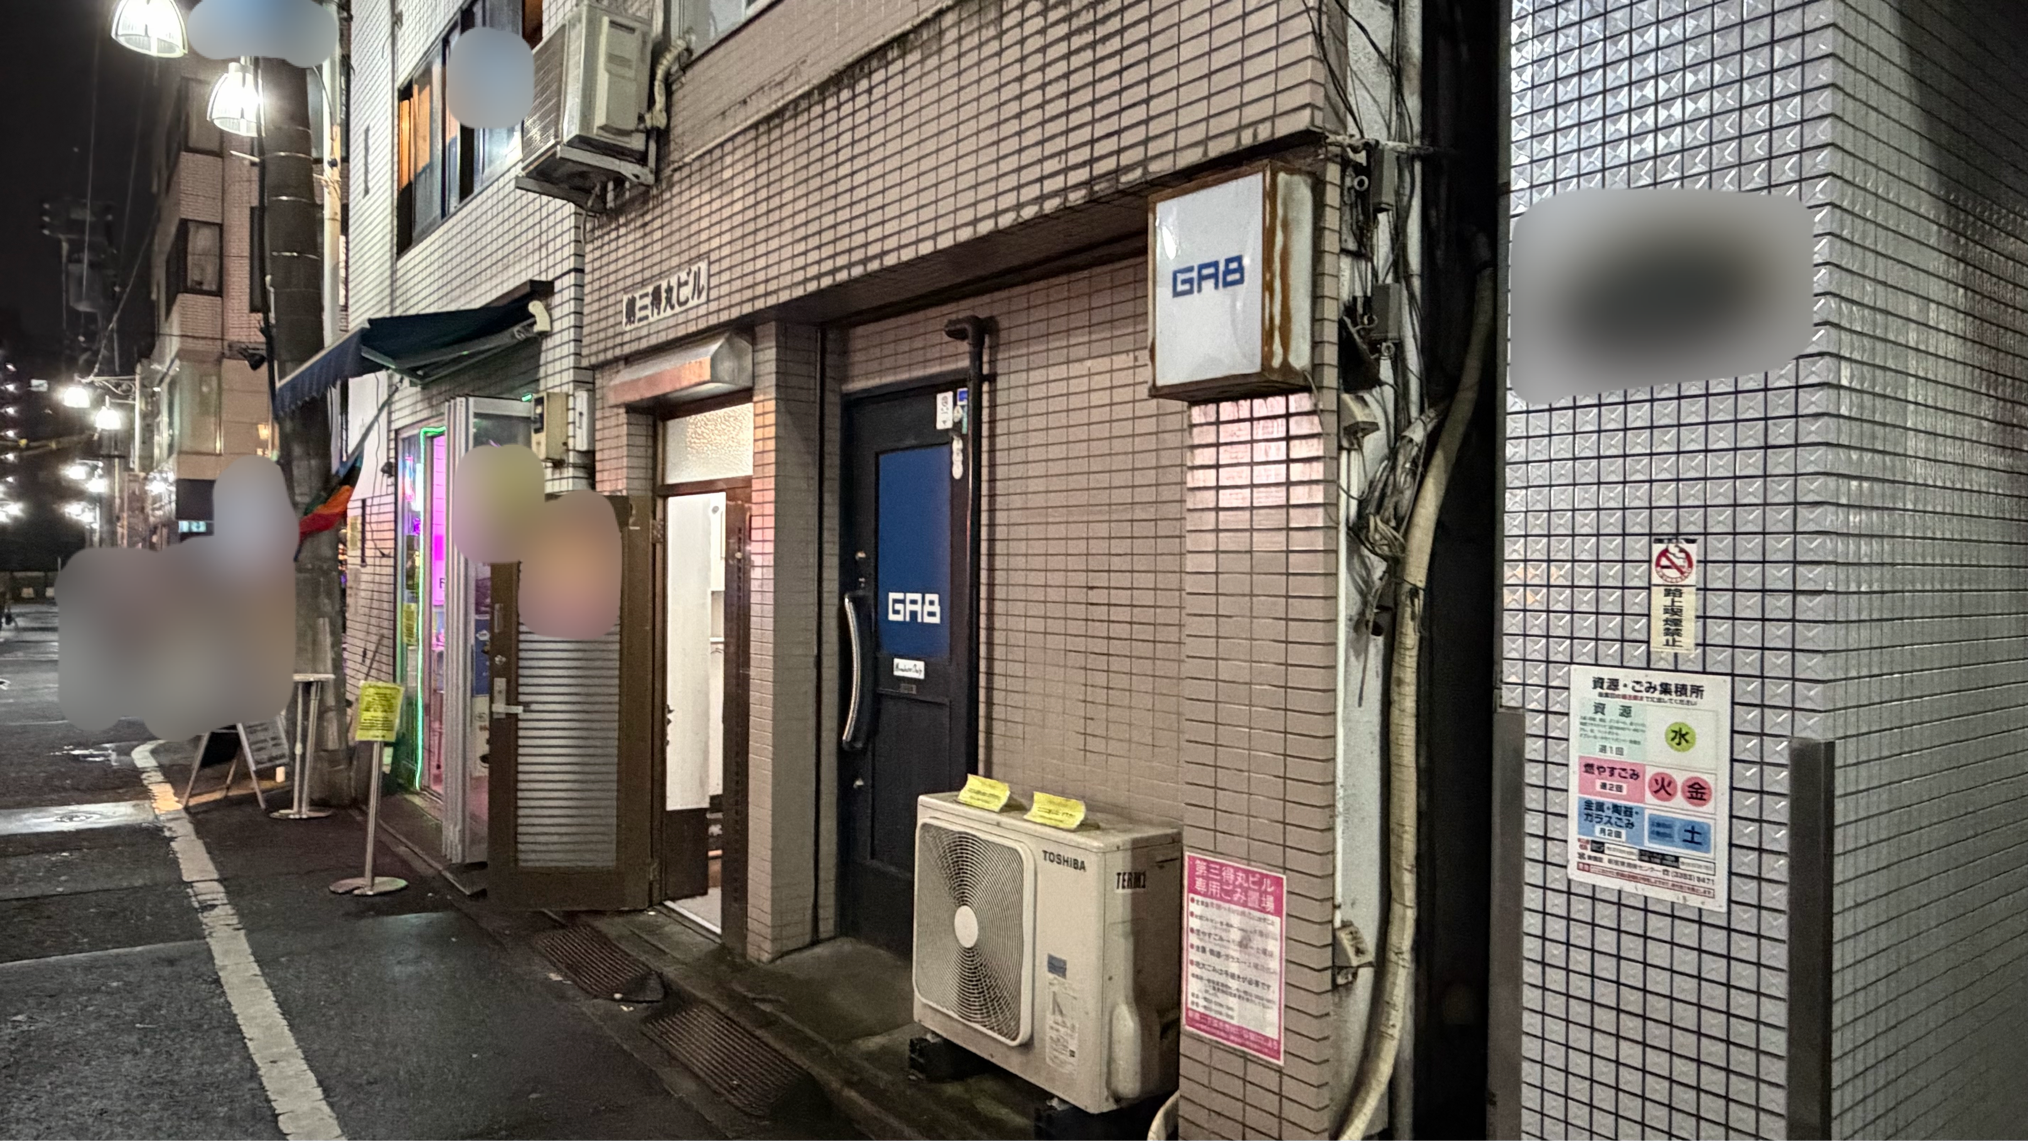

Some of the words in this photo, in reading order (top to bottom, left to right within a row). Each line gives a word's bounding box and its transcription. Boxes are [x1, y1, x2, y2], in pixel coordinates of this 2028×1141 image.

[1172, 254, 1245, 299] GAB
[888, 592, 941, 624] GAB
[1591, 676, 1705, 700] 資源・ごみ集積所
[1670, 727, 1690, 746] 水
[1653, 776, 1672, 797] 火
[1687, 781, 1707, 801] 金
[1682, 825, 1703, 846] 土
[1042, 850, 1087, 873] TOSHIBA
